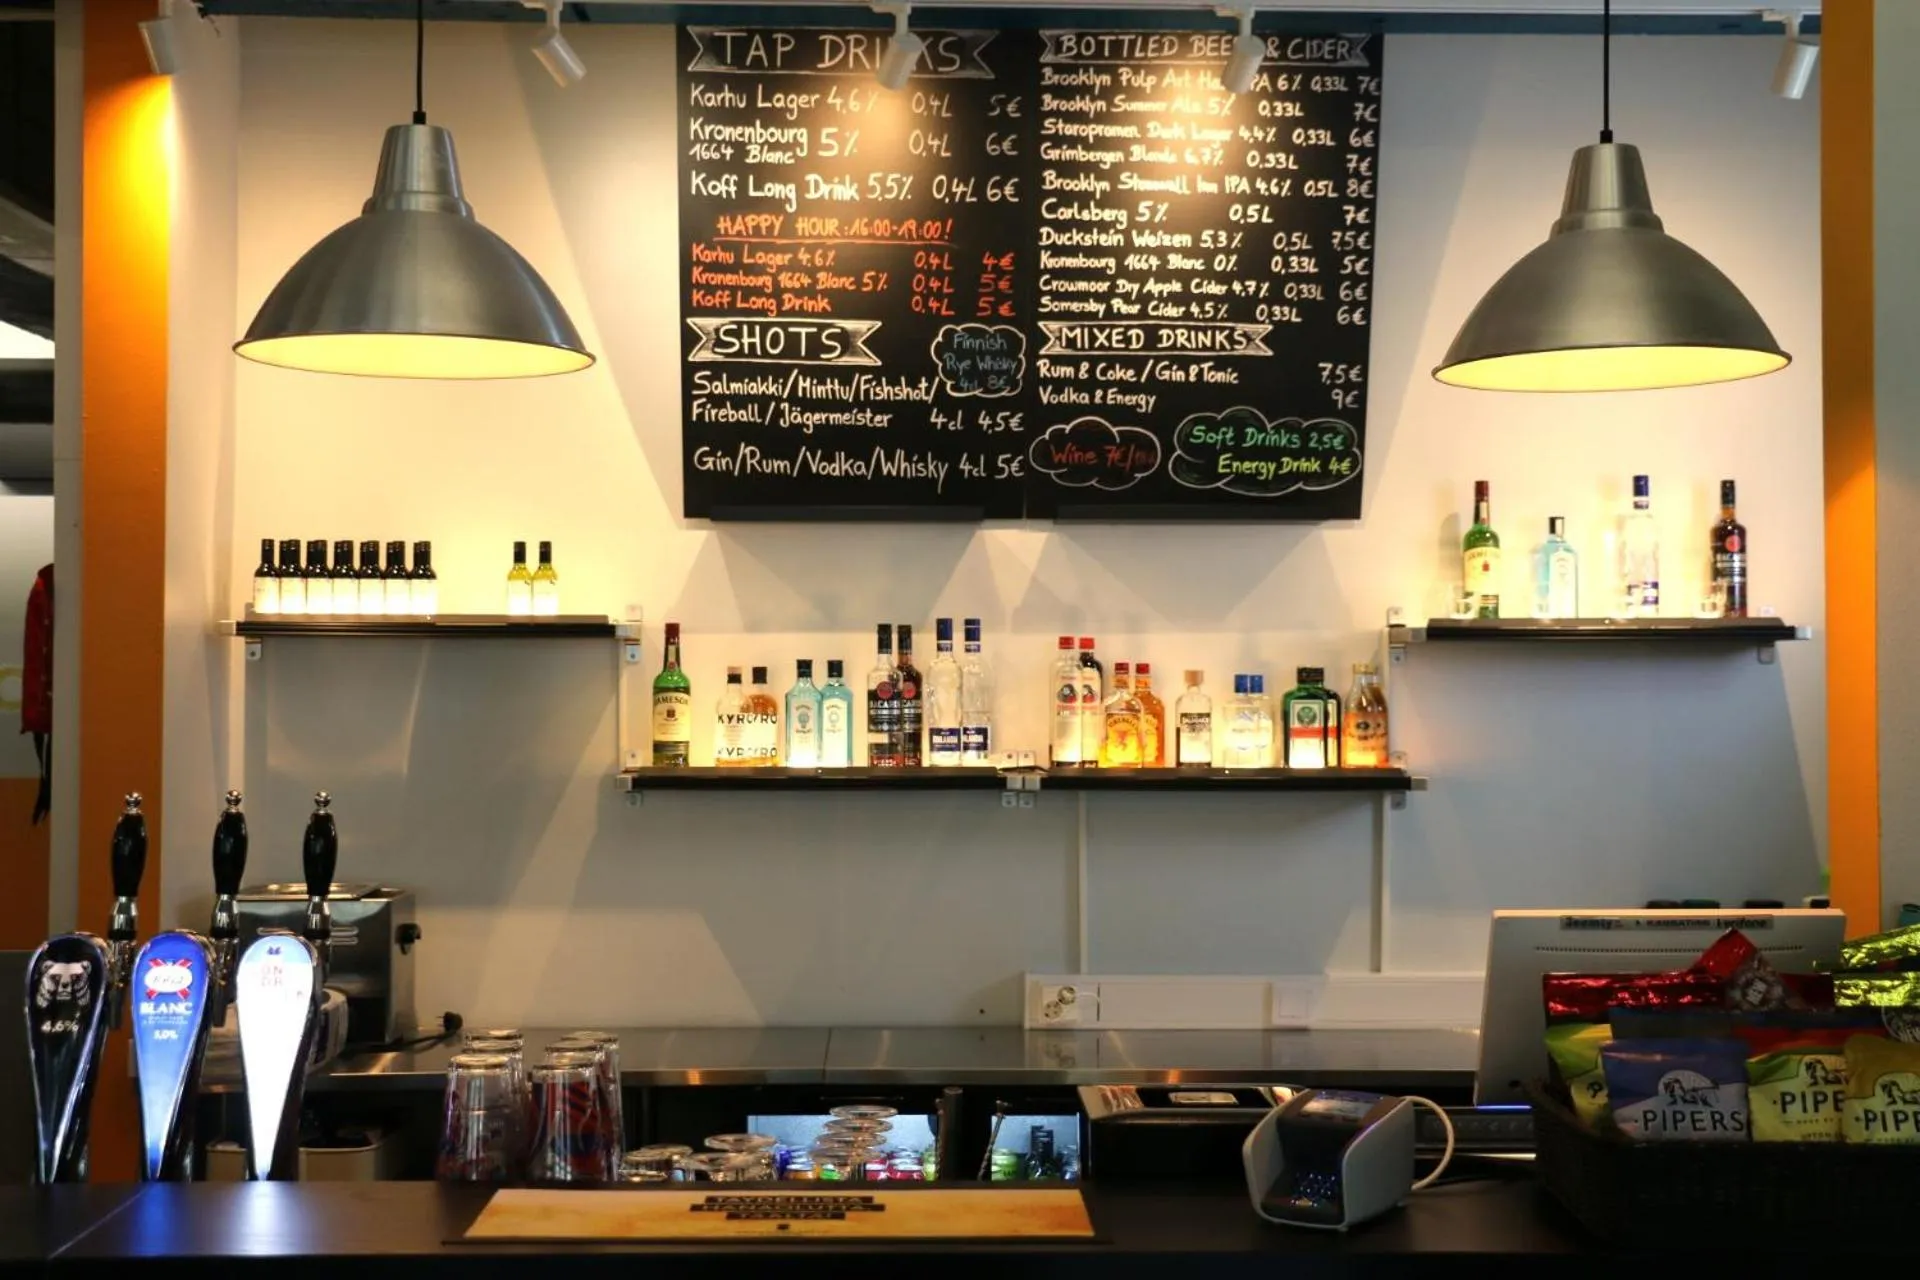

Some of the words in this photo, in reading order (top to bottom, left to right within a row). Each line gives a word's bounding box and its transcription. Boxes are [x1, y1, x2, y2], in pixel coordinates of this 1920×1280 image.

[713, 32, 795, 68] TAP
[816, 34, 961, 72] DRIKS
[1058, 34, 1179, 57] BOTTLED
[1187, 35, 1238, 57] BEE
[1267, 37, 1280, 57] &
[1287, 38, 1350, 60] CIDER
[1040, 67, 1111, 95] Brooklyn
[1118, 67, 1157, 94] Pulp
[691, 83, 746, 108] Karhu
[757, 84, 820, 120] Lager
[1041, 93, 1106, 118] Brooklyn
[690, 116, 808, 157] Kronenbourg
[1041, 119, 1141, 143] Staropramen
[689, 143, 734, 161] 1664
[745, 145, 795, 164] Blanc
[1040, 142, 1125, 169] Grimbergen
[691, 170, 738, 199] Koff
[749, 175, 796, 213] Long
[804, 174, 859, 201] Drink
[1042, 169, 1110, 199] Brooklyn
[1224, 175, 1251, 195] IPA
[717, 214, 783, 236] HAPPY
[1042, 197, 1128, 229] Carlsberg
[1038, 227, 1124, 247] Duckstein
[1131, 229, 1192, 248] Weizen
[692, 243, 734, 264] Karhu
[743, 244, 792, 272] Lager
[1124, 254, 1161, 271] 1664
[1166, 253, 1206, 270] Blanc
[692, 266, 772, 292] Kronenbourg
[778, 271, 811, 288] 1664
[816, 271, 857, 290] Blanc
[1039, 274, 1111, 293] Crowmoor
[1116, 279, 1141, 300] Dry
[1143, 277, 1183, 297] Apple
[1190, 278, 1229, 295] Cider
[692, 289, 731, 308] Koff
[736, 291, 776, 317] Long
[781, 293, 831, 312] Drink
[1038, 296, 1106, 318] Somersby
[1111, 298, 1141, 313] Pear
[1148, 300, 1185, 317] Cider
[714, 324, 841, 358] SHOTS
[953, 332, 1007, 350] Finnish
[1061, 327, 1145, 349] MIXED
[1157, 328, 1248, 350] DRINKS
[943, 352, 972, 375] Rye
[1036, 358, 1075, 379] Rum
[1096, 362, 1137, 381] Coke
[1039, 385, 1090, 406] Vodka
[1106, 387, 1156, 414] Energy
[1189, 425, 1236, 450] Soft
[1241, 426, 1301, 448] Drinks
[1050, 442, 1099, 465] Wine
[1217, 452, 1278, 480] Energy
[1278, 456, 1321, 475] Drink
[140, 1002, 192, 1015] BLANC
[1779, 1090, 1846, 1114] PIPE
[1642, 1110, 1746, 1133] PIPERS
[1863, 1108, 1920, 1133] PIPE
